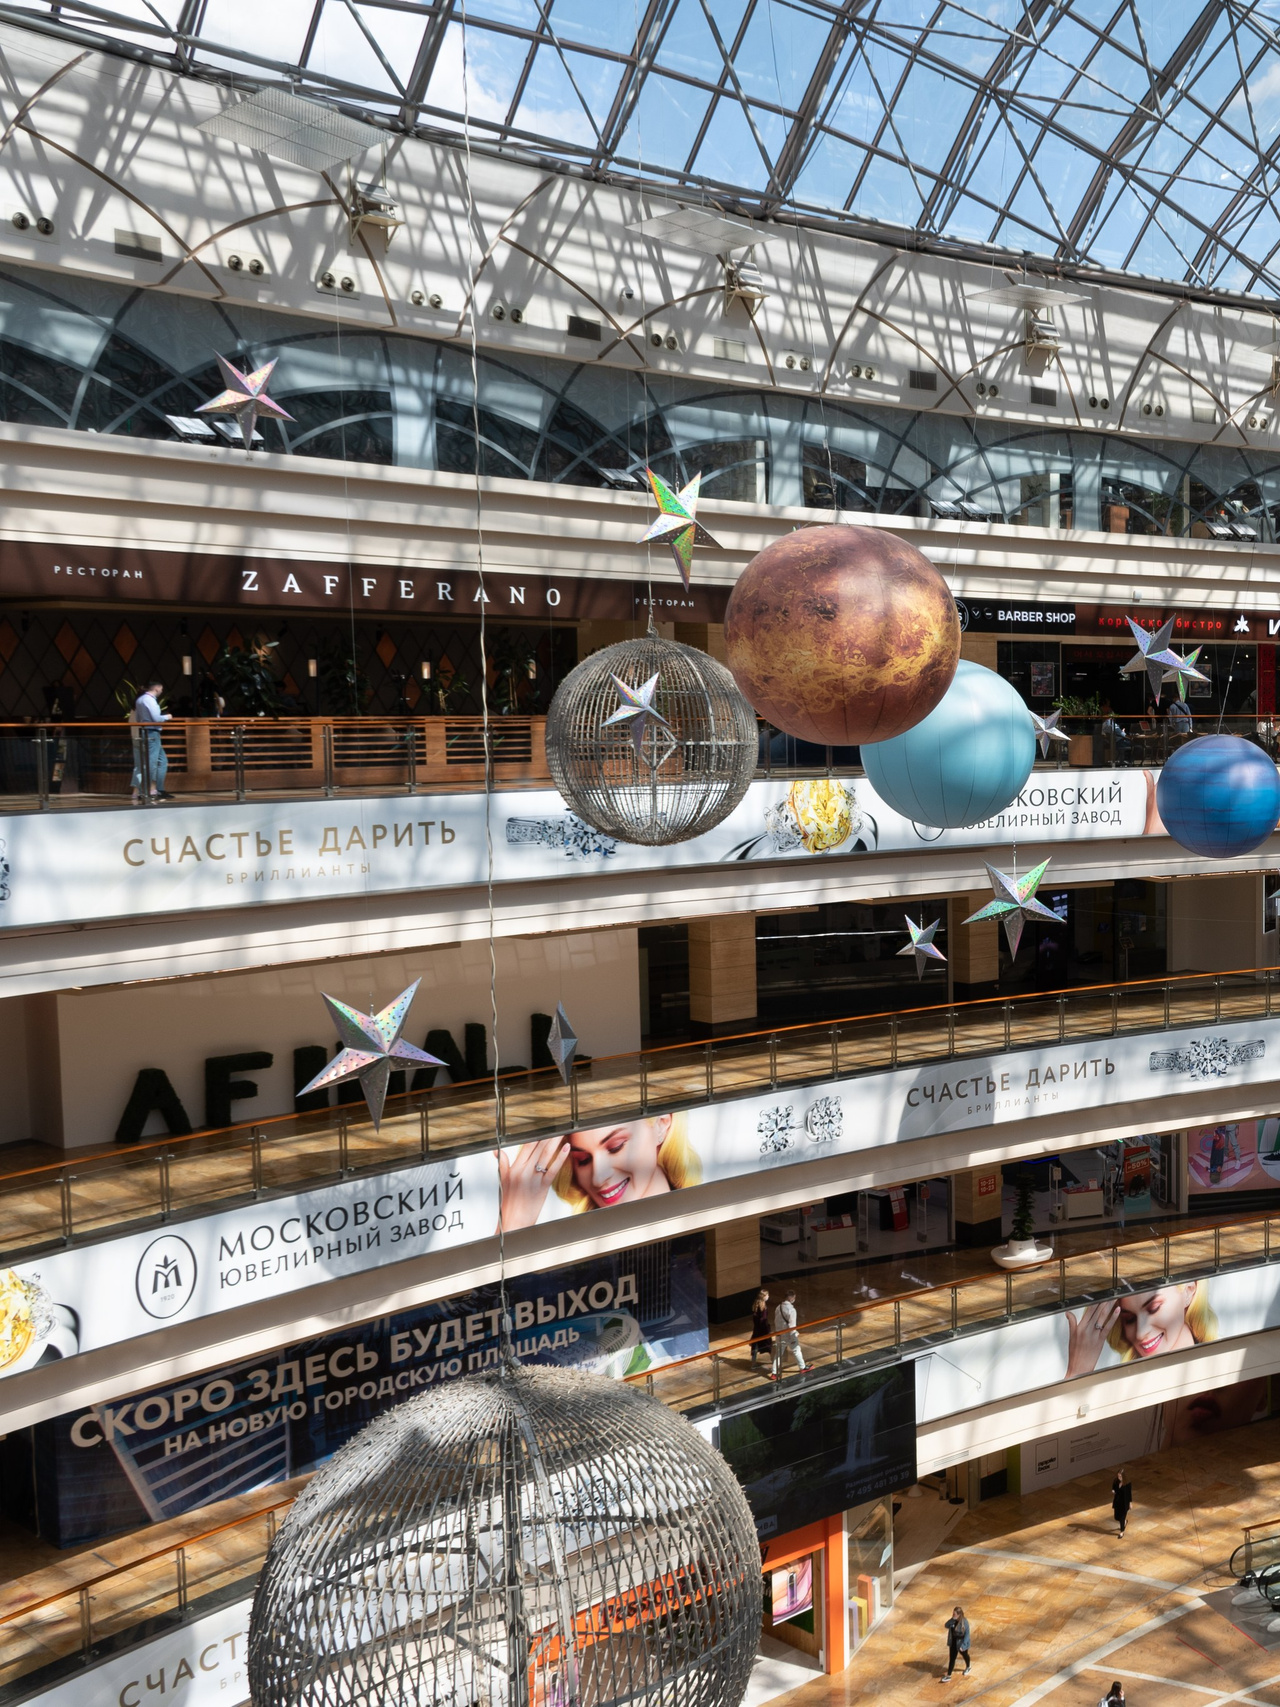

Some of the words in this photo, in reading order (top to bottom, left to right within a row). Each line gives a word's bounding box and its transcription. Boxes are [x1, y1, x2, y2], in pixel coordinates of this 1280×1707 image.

[54, 565, 143, 579] РЕСТОРАН
[241, 570, 562, 606] ZAFFERANO
[635, 597, 695, 607] РЕСТОРАН
[997, 610, 1043, 622] BARBER
[1045, 612, 1076, 623] SHOP
[1098, 616, 1168, 628] корейско
[1176, 617, 1222, 630] бистро
[1006, 781, 1122, 807] КОВСКИЙ
[1071, 810, 1122, 825] ЗАВОД
[123, 829, 295, 867] СЧАСТЬЕ
[318, 820, 457, 855] ДАРИТЬ
[226, 862, 372, 885] БРИЛЛИАНТЫ
[906, 1072, 1010, 1107] СЧАСТЬЕ
[1025, 1057, 1116, 1089] ДАРИТЬ
[967, 1092, 1060, 1115] БРИЛЛИАНТЫ
[218, 1172, 464, 1262] МОСКОВСКИЙ
[219, 1226, 381, 1289] ЮВЕЛИРНЫЙ
[390, 1210, 464, 1243] ЗАВОД
[70, 1378, 236, 1449] СКОРО
[246, 1345, 380, 1409] ЗДЕСЬ
[389, 1306, 502, 1364] БУДЕТ
[515, 1273, 640, 1330] ВЫХОД
[163, 1427, 203, 1457] НА
[208, 1401, 307, 1445] НОВУЮ
[313, 1357, 463, 1412] ГОРОДСКУЮ
[467, 1326, 581, 1369] ПЛОЩАДЬ
[119, 1631, 243, 1707] СЧАСТ
